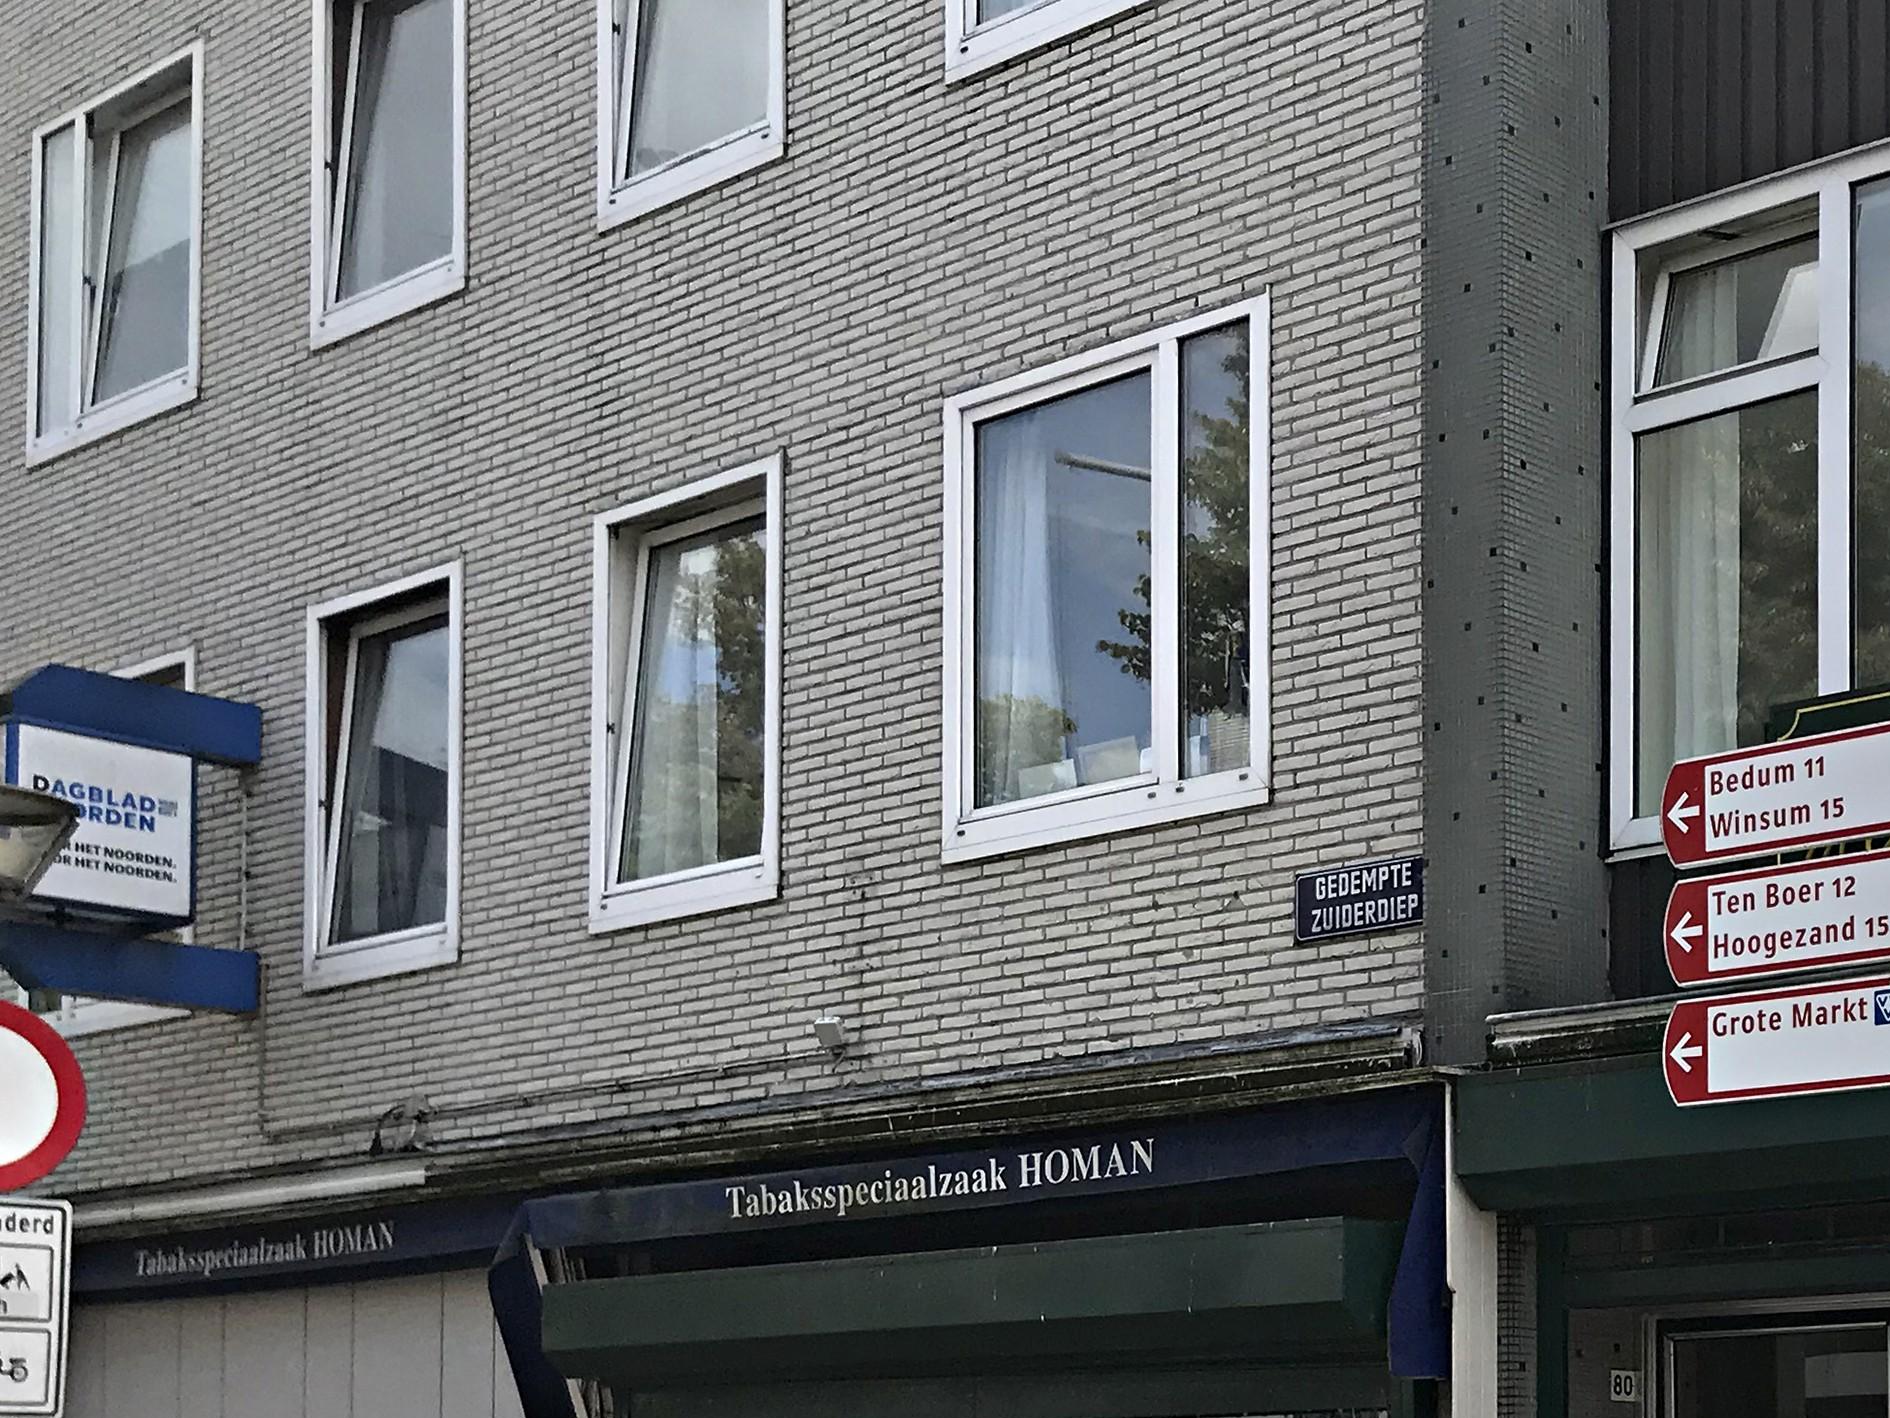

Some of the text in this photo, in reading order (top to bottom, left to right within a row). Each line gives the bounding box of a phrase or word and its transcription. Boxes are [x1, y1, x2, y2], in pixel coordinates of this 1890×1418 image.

[33, 774, 157, 813] DAGBLAD
[1710, 756, 1826, 797] Bedum 11
[74, 802, 156, 833] ORDEN
[1710, 796, 1845, 839] Winsum 15
[74, 857, 101, 871] HET
[75, 842, 102, 857] HET
[1315, 862, 1412, 900] GEDEMPTE
[1712, 876, 1857, 916] Ten Boer 12
[1311, 893, 1419, 933] ZUIDERDIEP
[1713, 915, 1890, 959] Hoogezand 15
[1712, 1009, 1782, 1037] Grote
[1792, 997, 1869, 1029] Markt
[726, 1138, 1156, 1220] Tabaksspeciaalzaak HOMAN
[0, 1211, 54, 1235] derd
[135, 1220, 395, 1278] Tabaksspeciaalzaak HOMAN
[1613, 1374, 1633, 1397] 80
